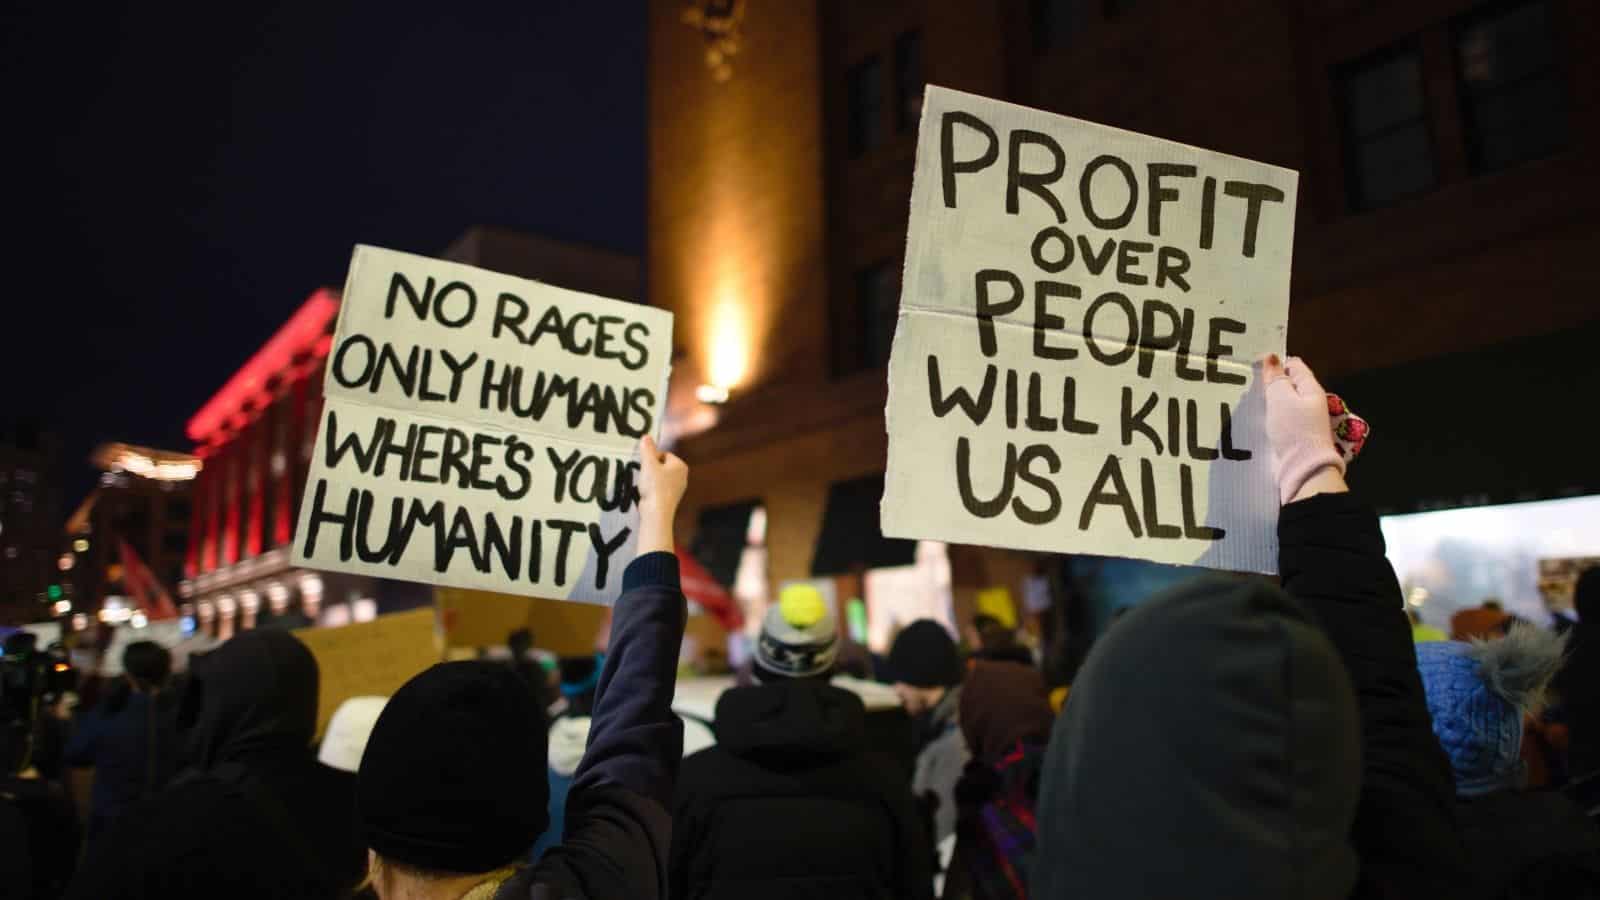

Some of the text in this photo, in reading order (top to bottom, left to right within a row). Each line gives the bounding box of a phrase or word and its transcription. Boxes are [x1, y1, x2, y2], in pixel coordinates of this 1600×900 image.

[940, 110, 1285, 258] PROFIT
[1030, 226, 1191, 293] OVER
[385, 272, 650, 371] NO RACES
[975, 268, 1247, 386] PEOPLE
[332, 334, 655, 439] ONLY HUMANS
[927, 354, 1253, 461] WILL KILL
[325, 410, 534, 501] WHERE'S
[956, 436, 1227, 541] US ALL
[303, 479, 632, 591] HUMANITY
